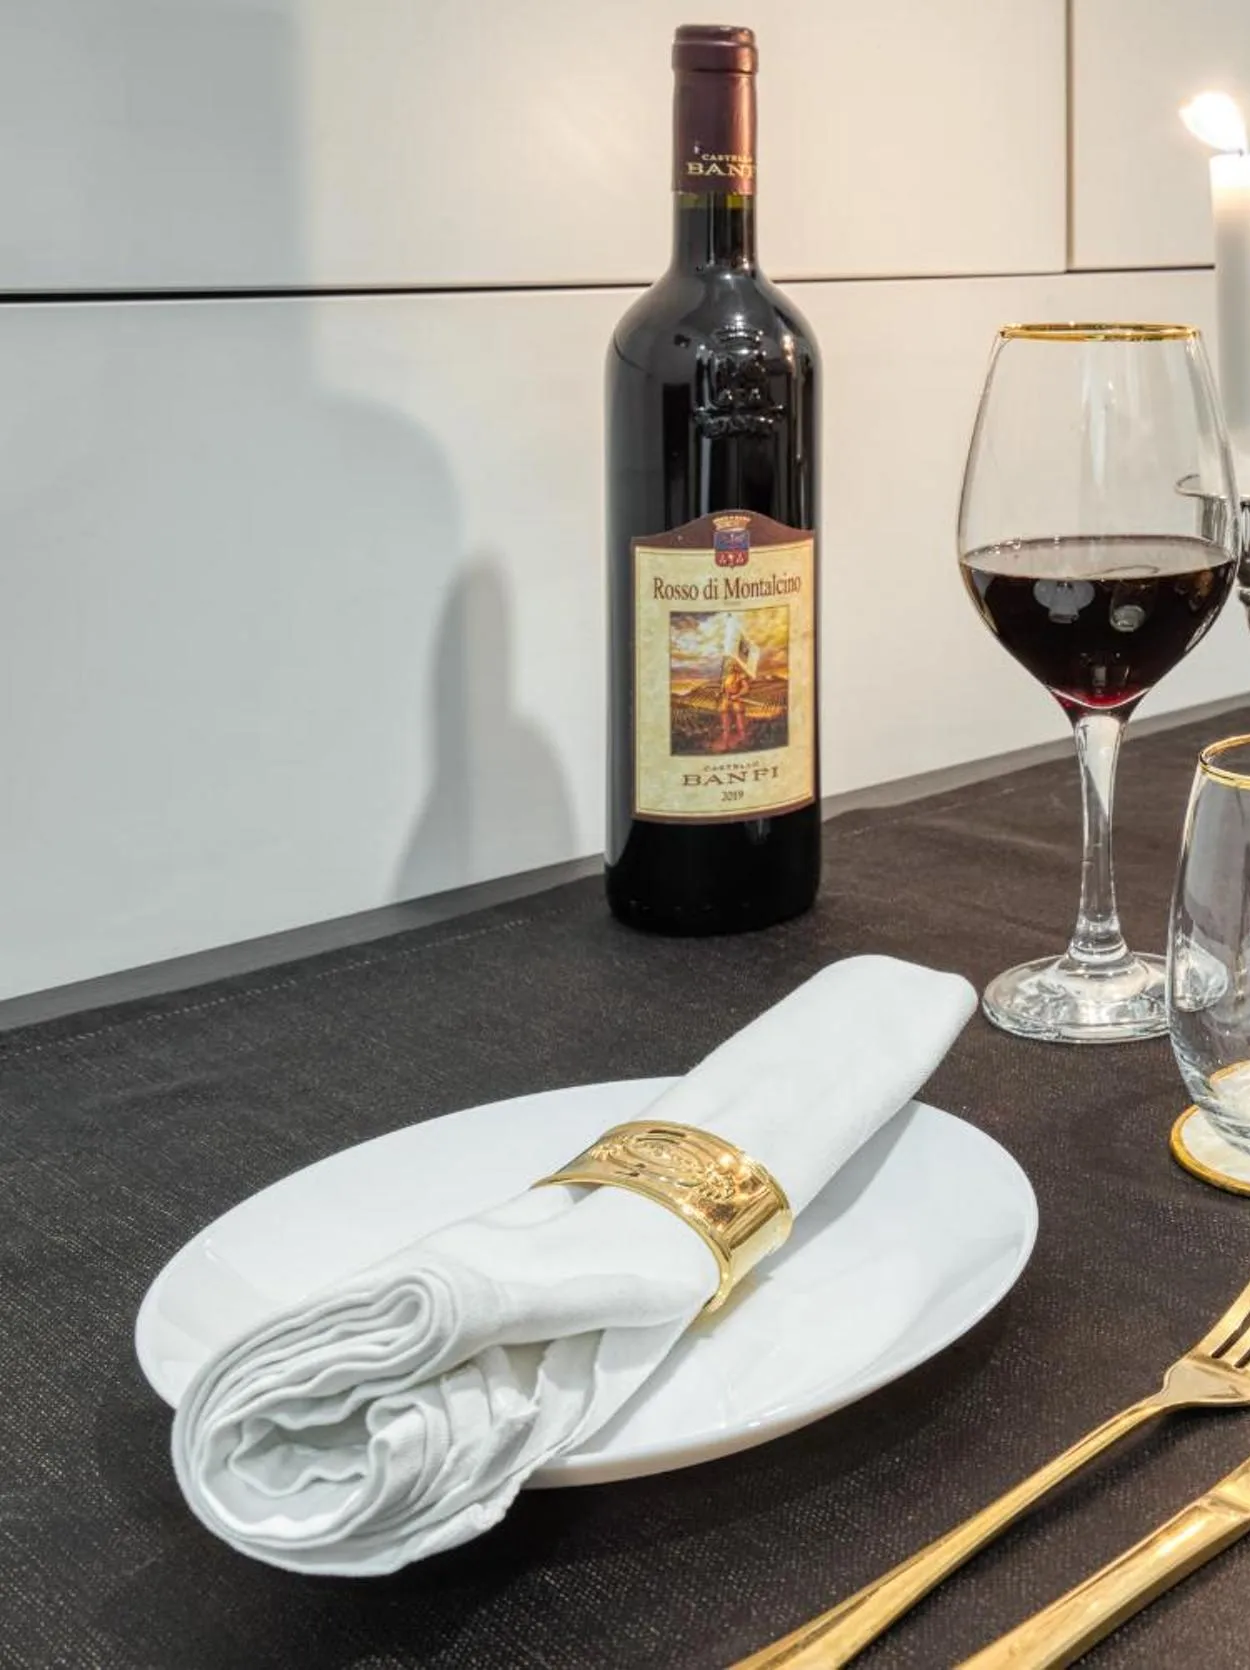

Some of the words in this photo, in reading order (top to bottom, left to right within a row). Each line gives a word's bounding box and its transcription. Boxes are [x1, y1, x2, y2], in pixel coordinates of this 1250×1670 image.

[653, 577, 699, 600] Rosso
[703, 578, 718, 600] di
[724, 573, 801, 600] Montalcino
[682, 766, 779, 786] BANFI
